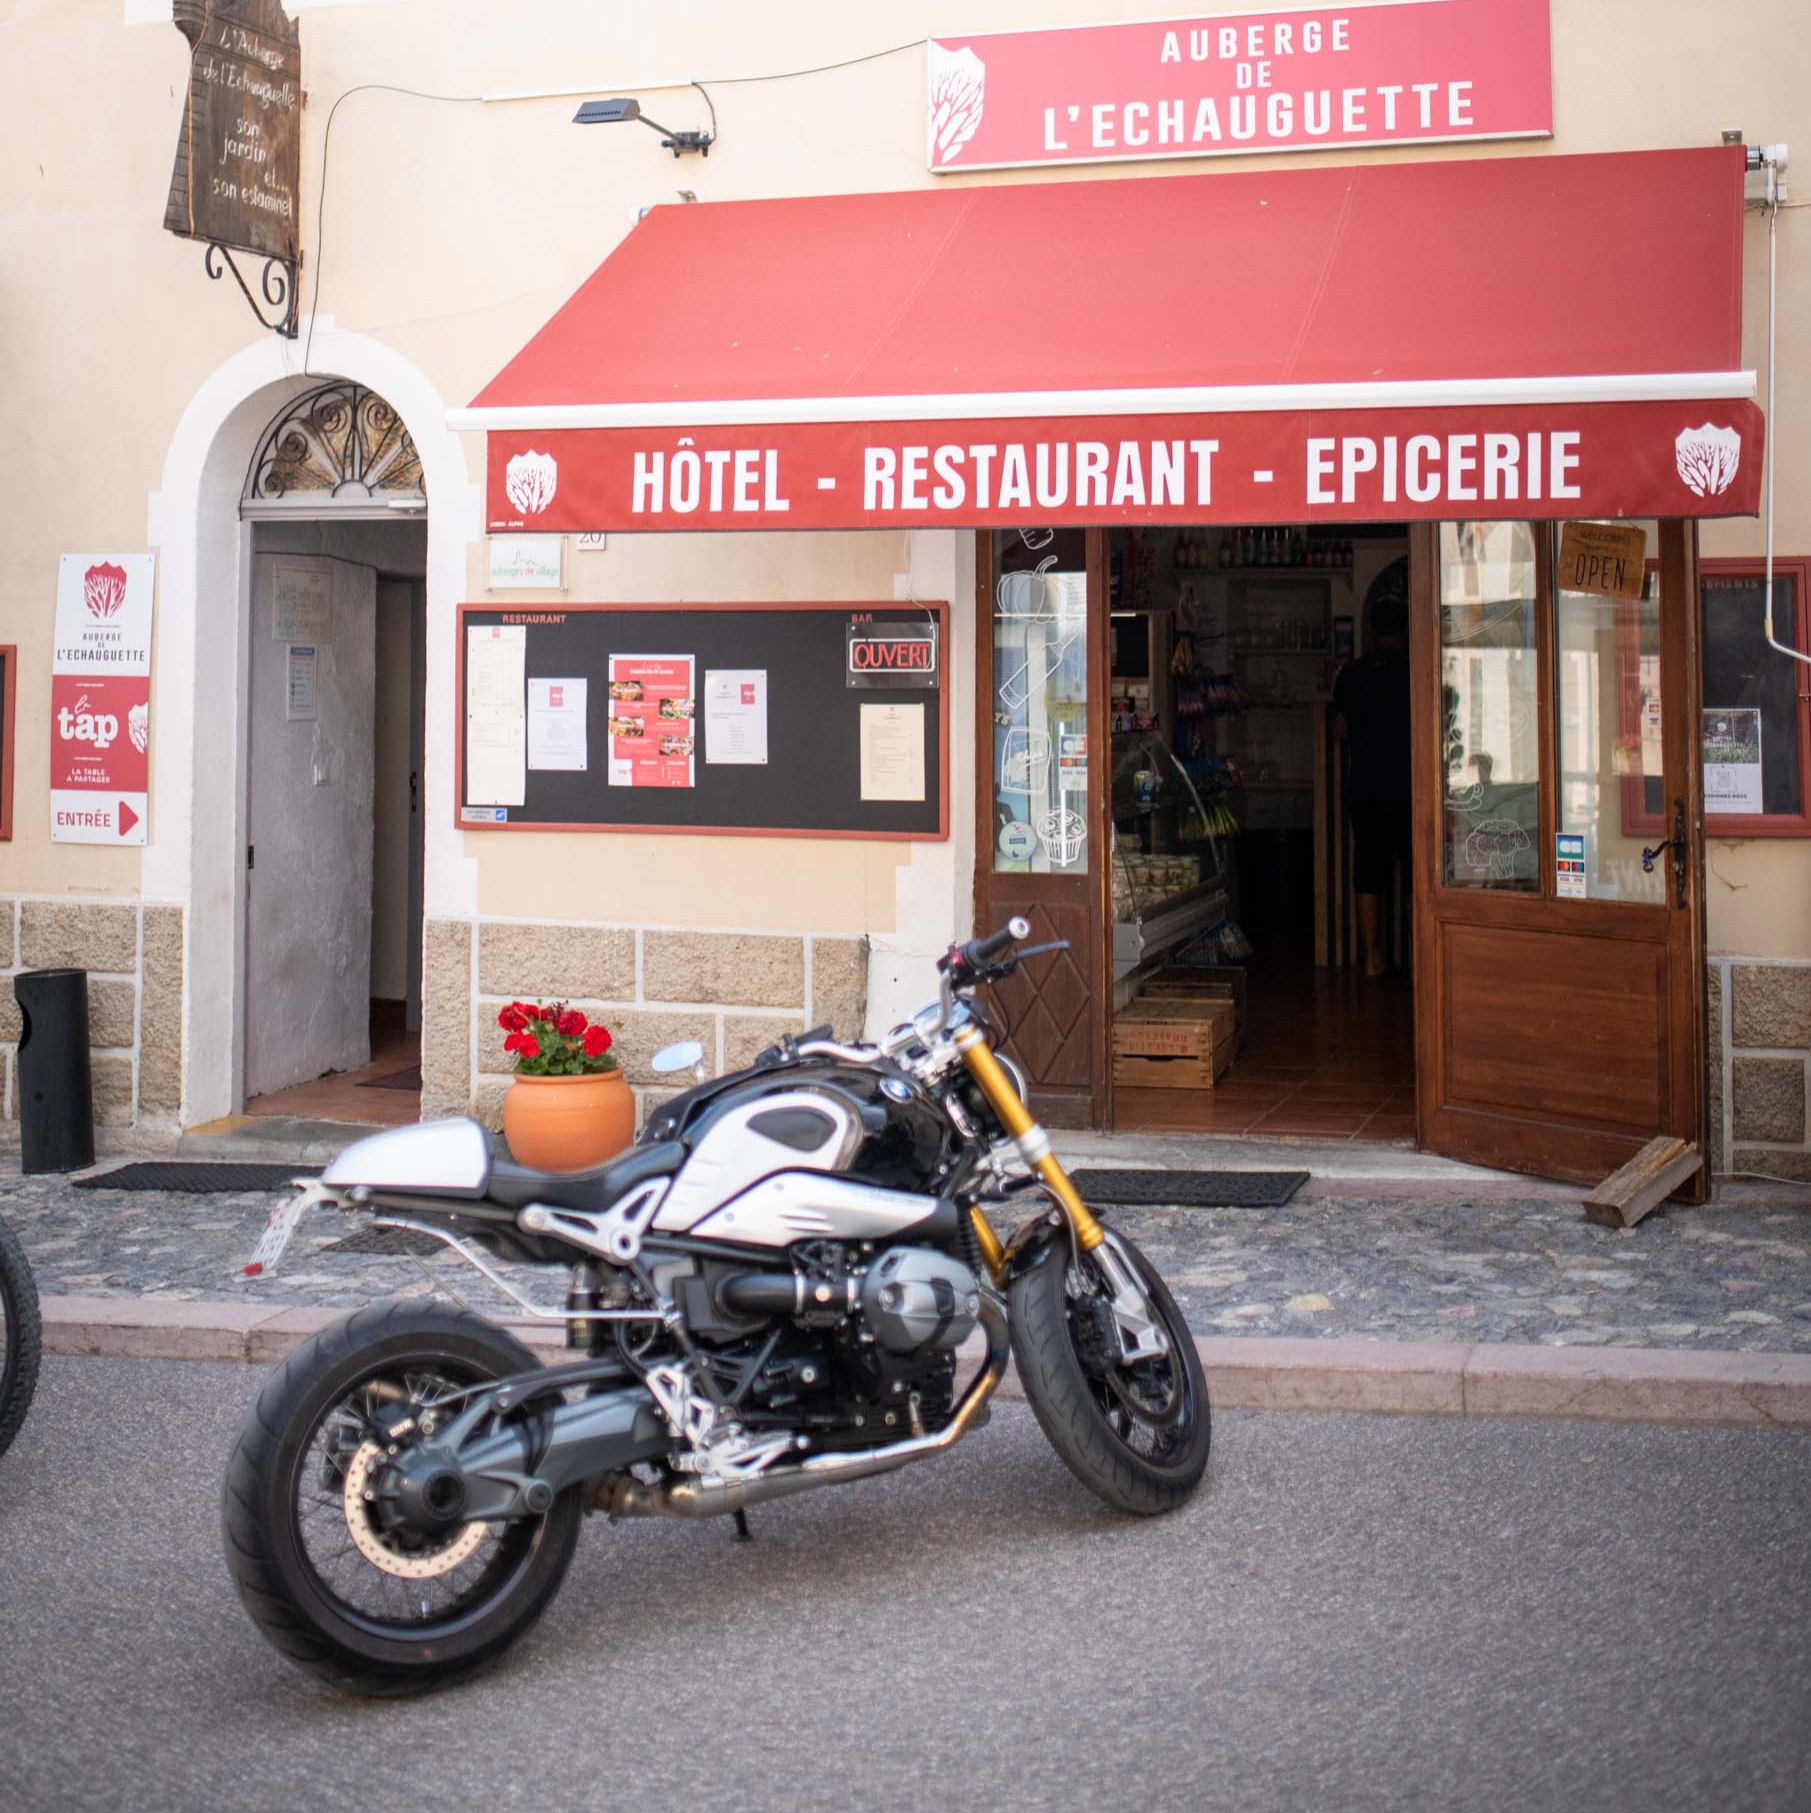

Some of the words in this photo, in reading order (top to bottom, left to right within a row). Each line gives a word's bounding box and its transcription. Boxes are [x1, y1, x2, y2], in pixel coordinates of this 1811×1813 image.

[1160, 19, 1350, 64] AUBERGE
[1236, 61, 1272, 88] DE
[1044, 80, 1474, 151] L'ECHAUGUETTE
[236, 118, 260, 137] son
[219, 131, 267, 165] jardin
[213, 179, 237, 200] son
[631, 437, 790, 513] HÔTEL
[863, 440, 1219, 511] RESTAURANT
[1306, 431, 1581, 504] EPICERIE
[1575, 553, 1626, 592] OPEN
[502, 614, 567, 624] RESTAURANT
[851, 613, 873, 624] BAR
[82, 632, 123, 642] AUBERGE
[57, 649, 145, 662] L'ECHAUGUETTE
[853, 643, 930, 668] OUVERT
[57, 707, 119, 748] tap
[74, 776, 111, 784] PARTAGER
[83, 769, 105, 777] TABLE
[57, 809, 111, 828] ENTRÉE
